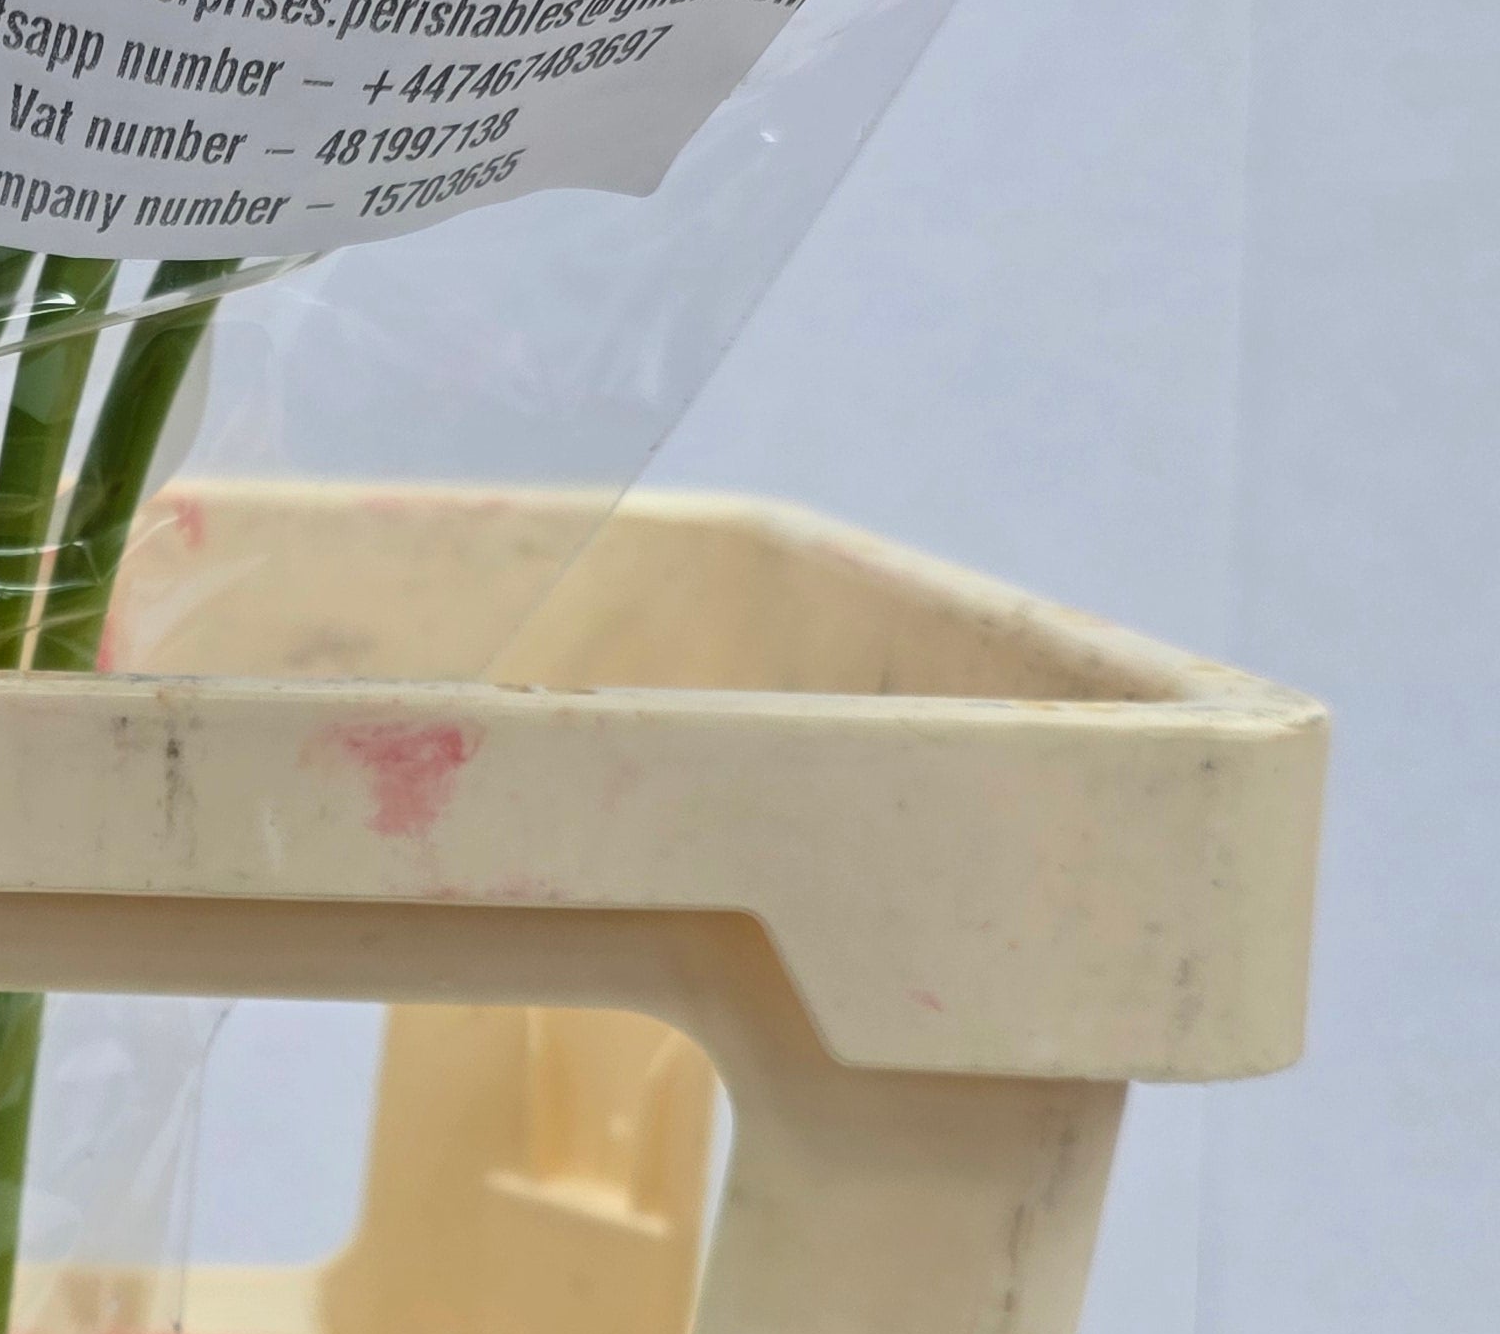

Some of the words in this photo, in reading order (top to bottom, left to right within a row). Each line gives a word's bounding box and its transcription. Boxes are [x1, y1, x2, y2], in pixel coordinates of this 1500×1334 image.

[117, 40, 285, 96] number
[363, 24, 673, 105] +447467483697
[10, 83, 73, 144] Vat
[85, 116, 248, 164] number
[315, 107, 519, 165] 481997138
[134, 190, 291, 226] number
[360, 149, 526, 217] 15703655
